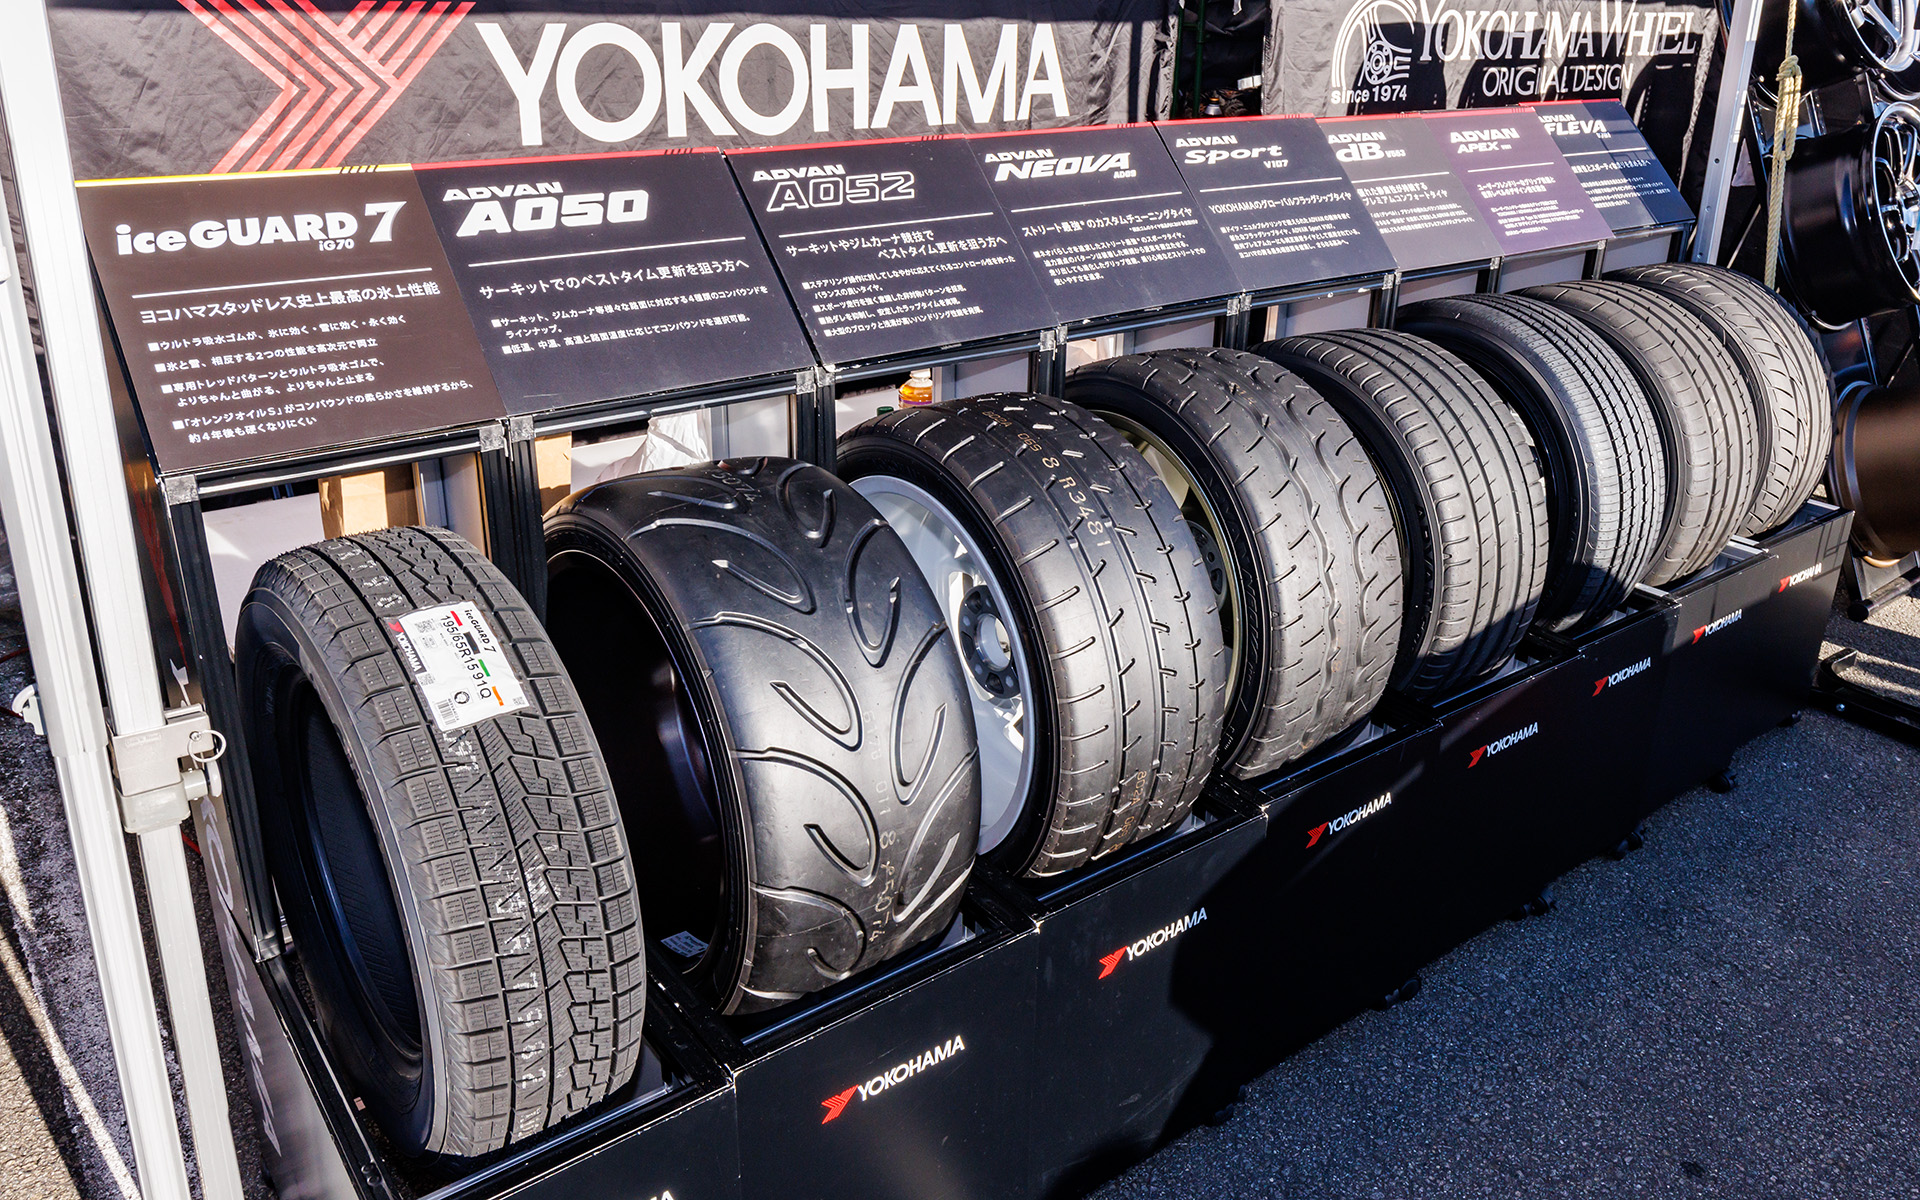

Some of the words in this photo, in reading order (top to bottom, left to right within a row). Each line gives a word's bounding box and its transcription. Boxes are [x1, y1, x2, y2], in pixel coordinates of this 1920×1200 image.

[475, 22, 1070, 145] YOKOHAMA
[1572, 63, 1633, 92] DESIGN
[1331, 88, 1369, 104] since
[1372, 84, 1408, 102] 1974
[1176, 135, 1238, 148] ADVAN
[1328, 131, 1386, 145] ADVAN
[1450, 128, 1520, 144] ADVAN
[1543, 120, 1607, 136] FLEVA
[984, 149, 1054, 163] ADVAN
[1184, 145, 1283, 165] Sport
[1335, 142, 1385, 162] dB
[1457, 141, 1499, 154] APEX
[752, 164, 846, 182] ADVAN
[994, 152, 1131, 182] NEOVA
[442, 182, 564, 202] ADVAN
[766, 171, 915, 212] A052
[115, 212, 358, 255] iceGUARD
[364, 201, 407, 243] 7
[456, 190, 649, 237] A050
[318, 238, 355, 252] iG70
[479, 259, 749, 299] サーキットでのベストタイム更新を狙う方へ
[140, 281, 440, 323] ヨコハマスタッドレス史上最高の氷上性能
[1788, 562, 1822, 587] YOKOHAMA
[464, 609, 490, 644] iceGUARD
[1704, 609, 1743, 637] YOKOHAMA
[395, 632, 423, 672] YOKOHAMA
[440, 615, 480, 672] 195/65R15
[472, 672, 492, 700] 91Q
[1607, 656, 1652, 688] YOKOHAMA
[1486, 721, 1539, 758] YOKOHAMA
[1328, 792, 1392, 835] YOKOHAMA
[1125, 906, 1208, 961] YOKOHAMA
[857, 1034, 966, 1102] YOKOHAMA
